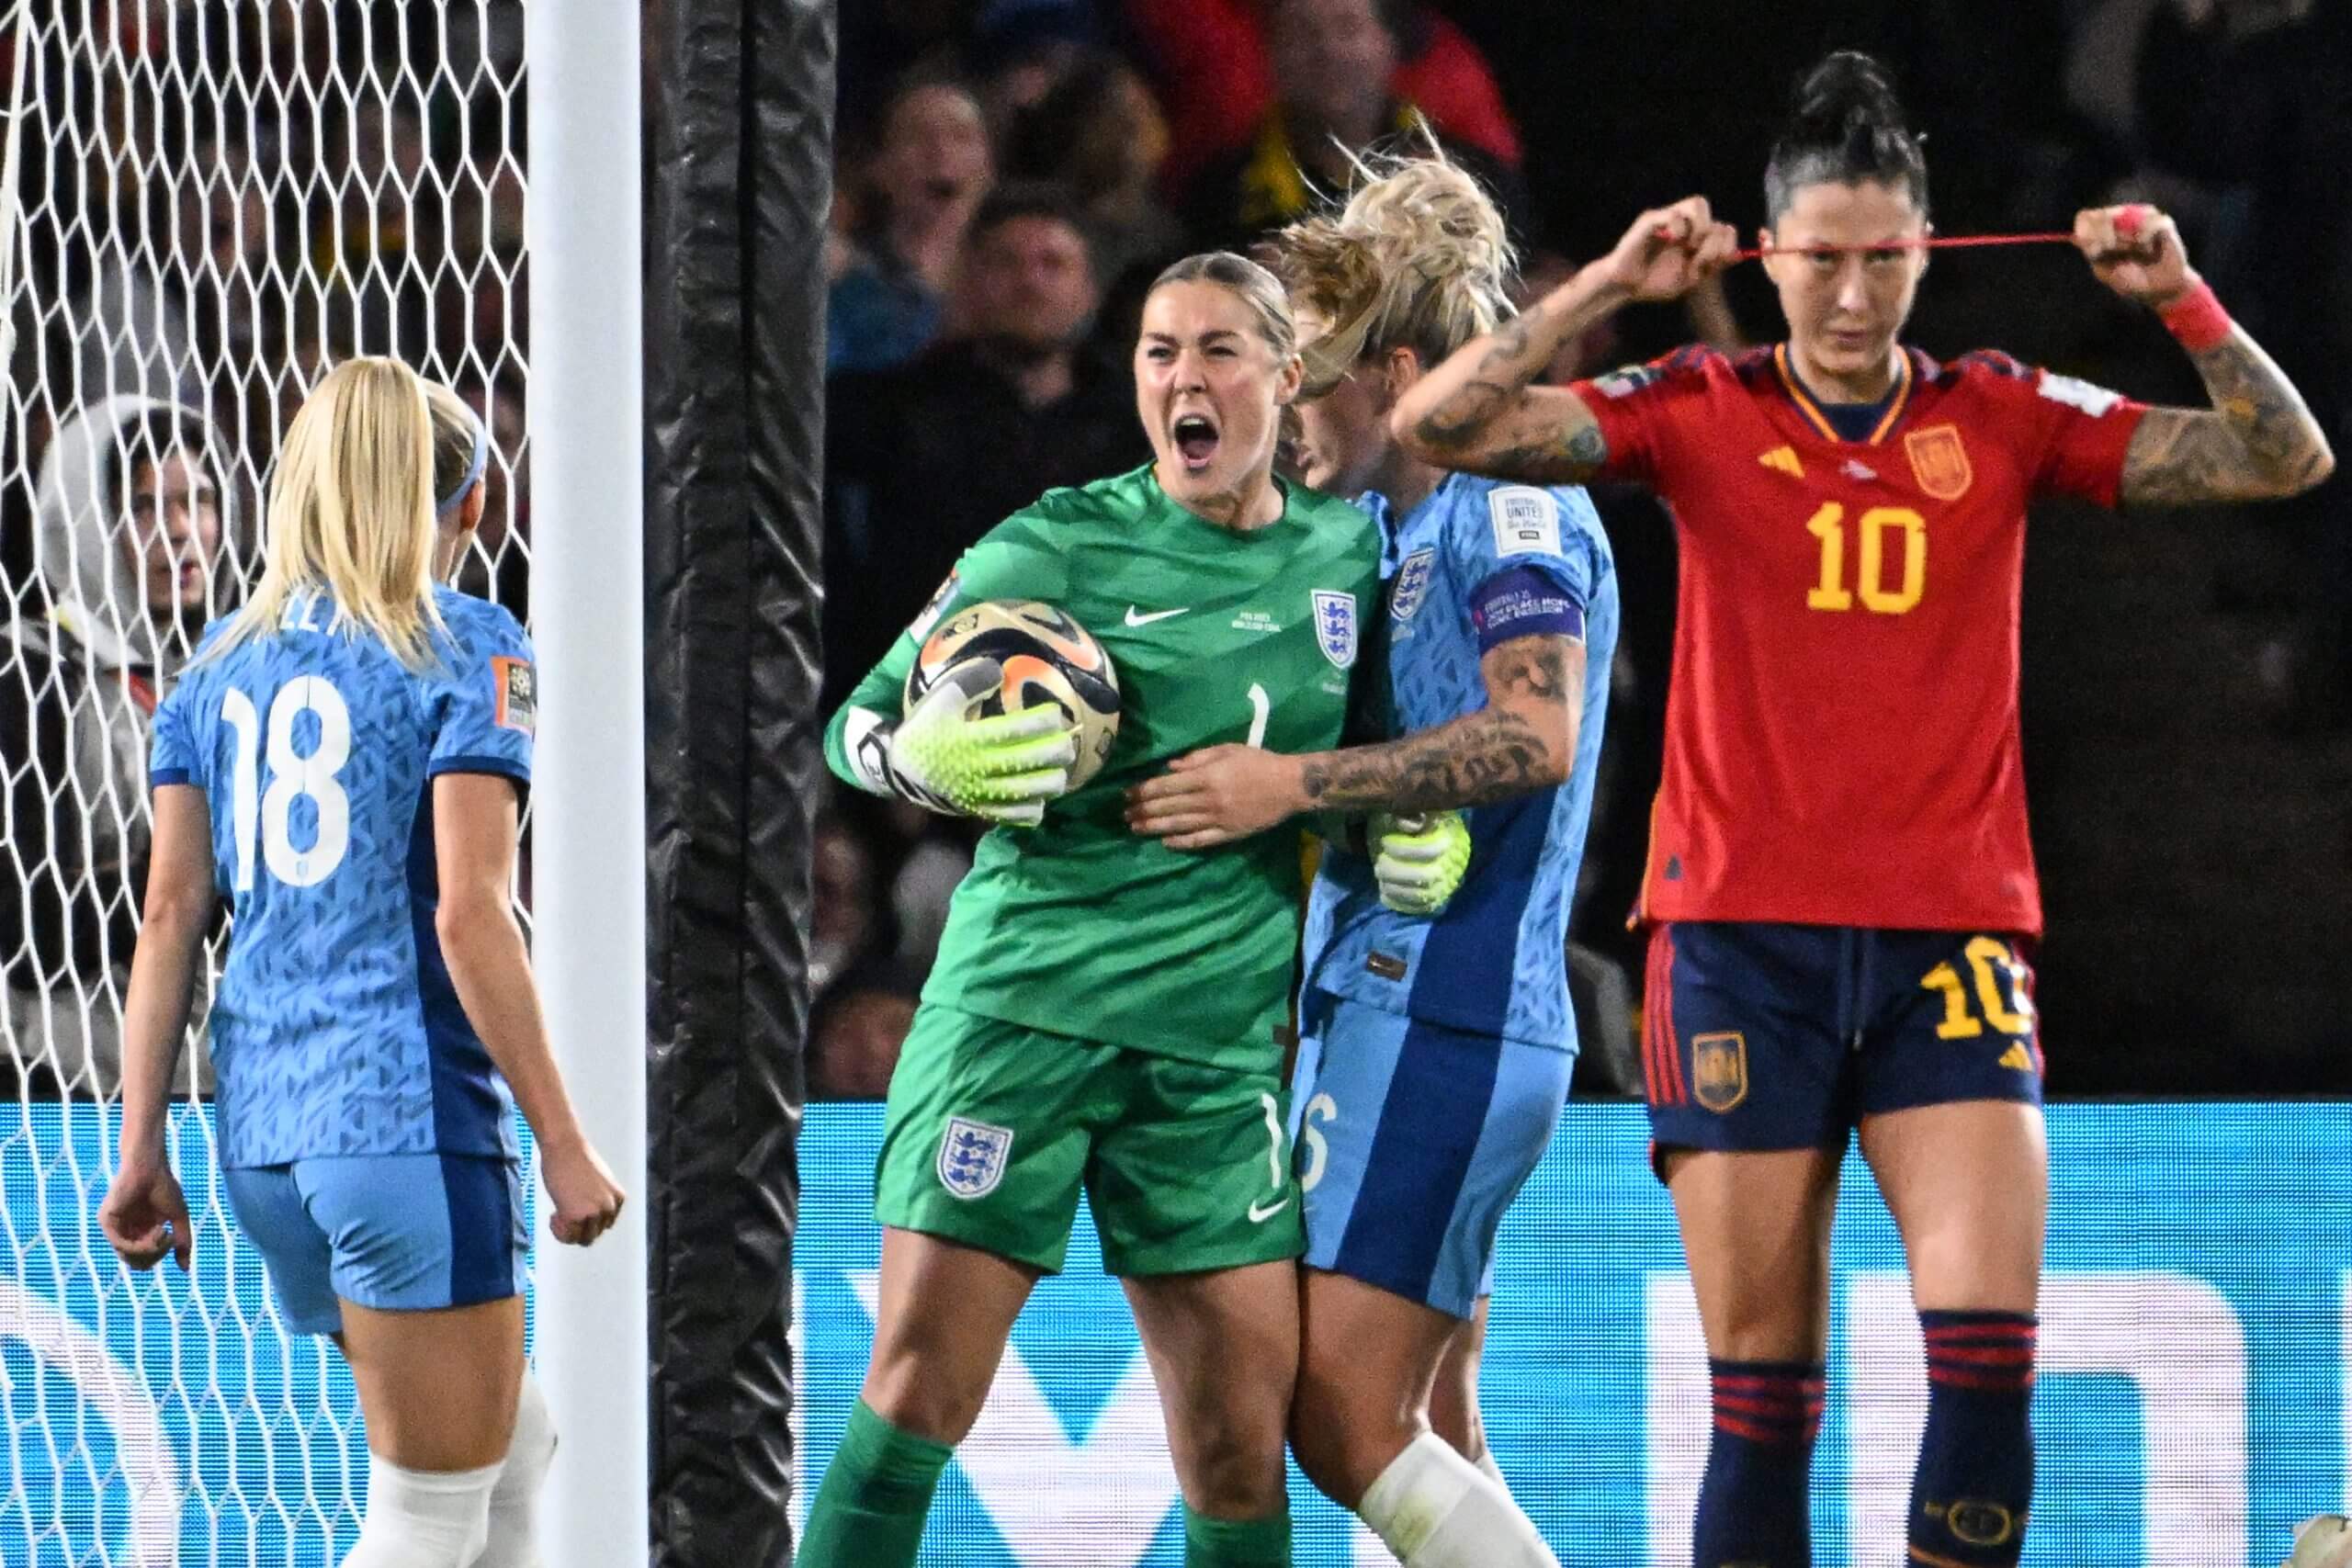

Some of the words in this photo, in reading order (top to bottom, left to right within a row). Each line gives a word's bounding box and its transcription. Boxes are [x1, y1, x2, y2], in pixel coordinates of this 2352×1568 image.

[1805, 502, 1927, 615] 10
[1247, 682, 1271, 750] 1
[220, 675, 351, 892] 18
[1919, 935, 2033, 1040] 10
[1261, 1092, 1283, 1189] 1
